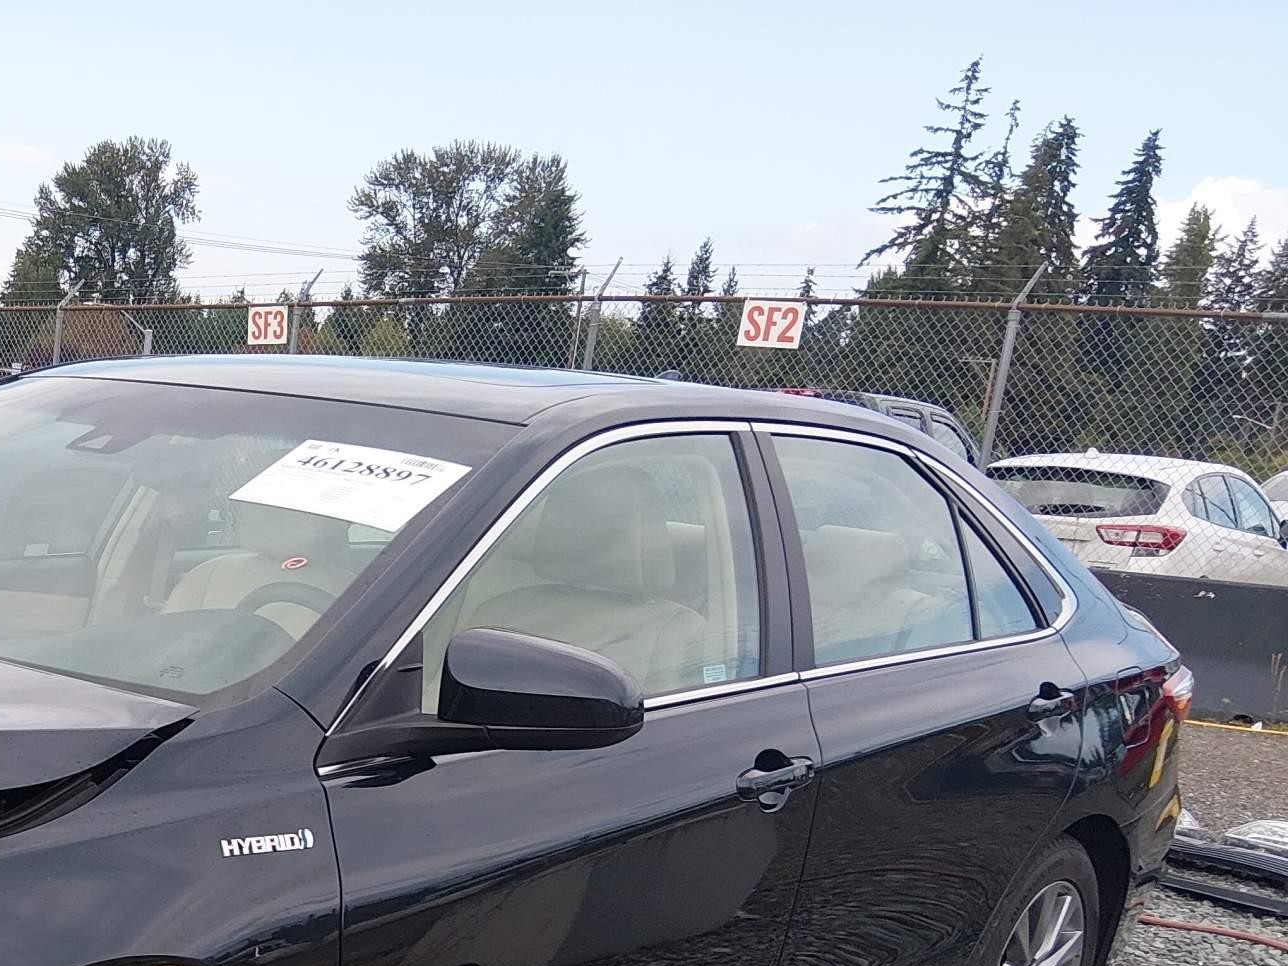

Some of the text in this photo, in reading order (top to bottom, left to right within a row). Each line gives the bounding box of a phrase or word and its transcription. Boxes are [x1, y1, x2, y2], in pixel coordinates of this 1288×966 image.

[251, 310, 284, 340] SF3
[744, 305, 799, 343] SF2
[297, 455, 431, 486] 46128897
[220, 833, 301, 857] HYBRID
